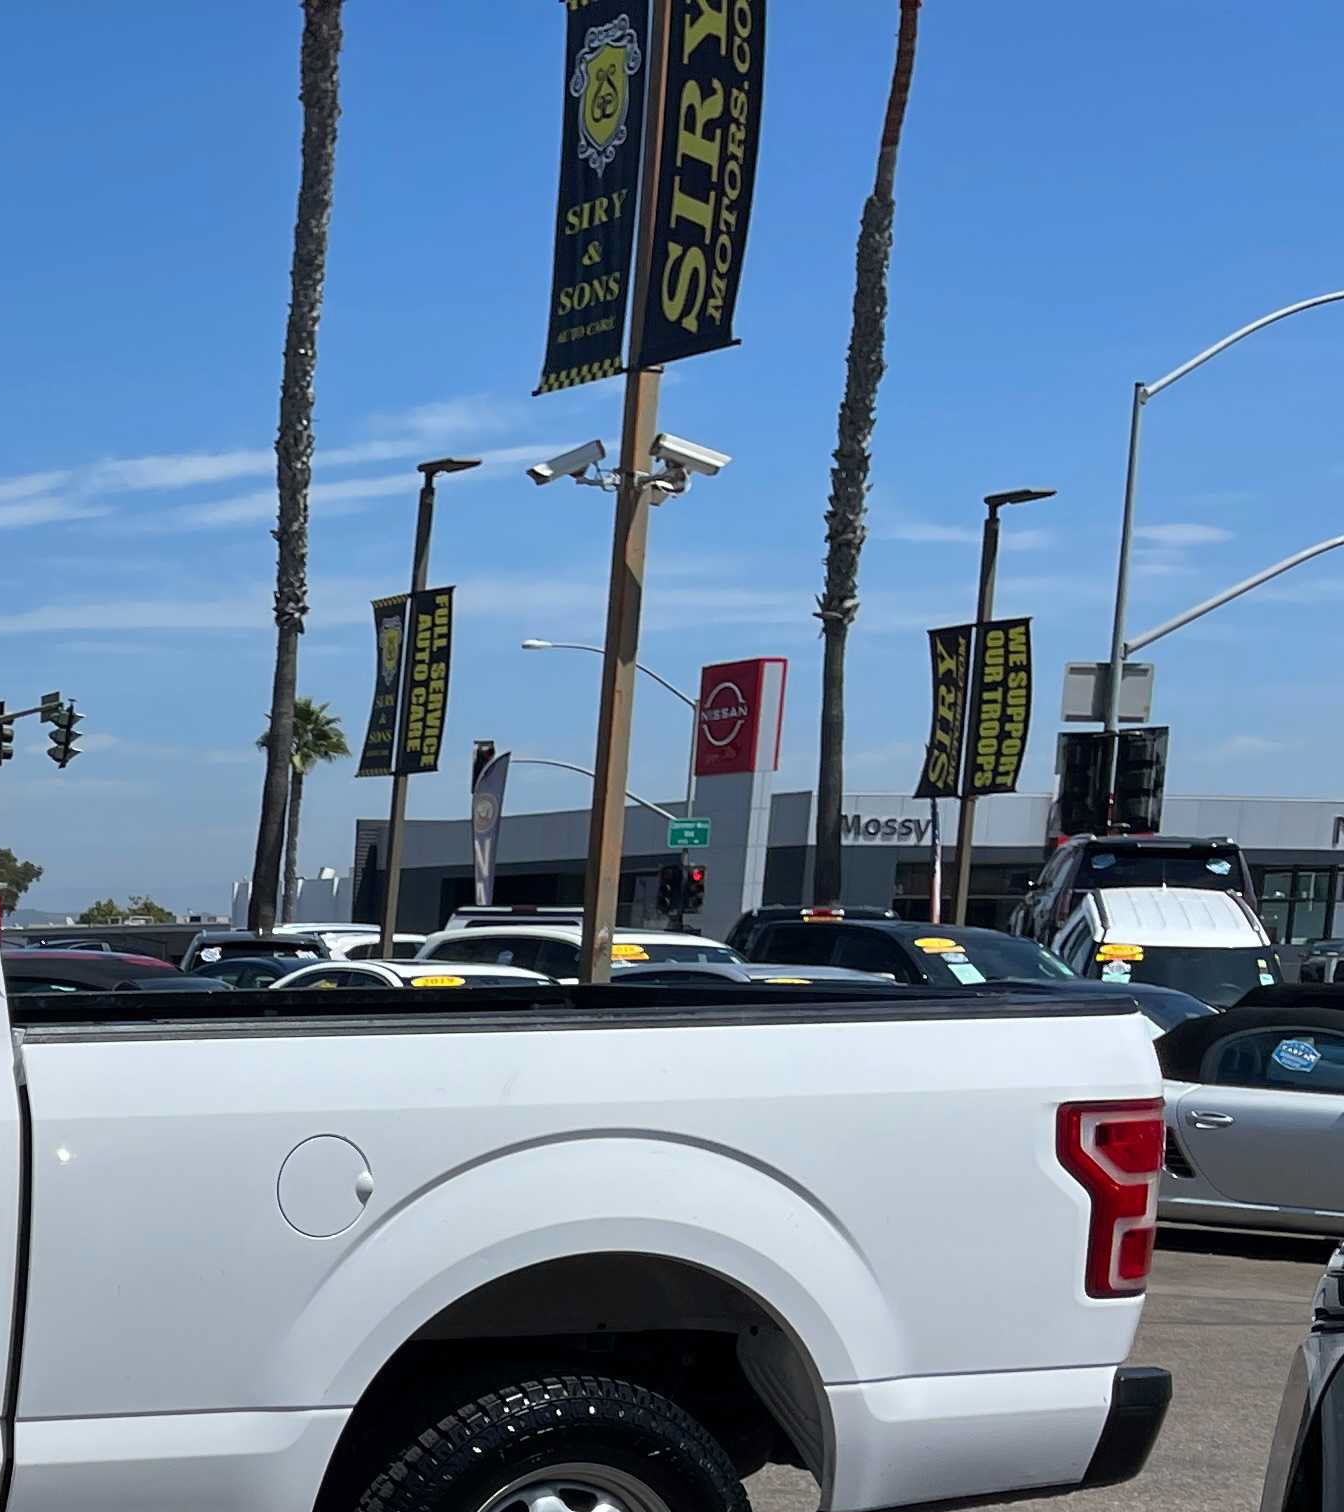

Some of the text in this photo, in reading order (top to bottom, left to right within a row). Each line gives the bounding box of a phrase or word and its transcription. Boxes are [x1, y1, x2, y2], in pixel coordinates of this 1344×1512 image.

[564, 189, 628, 235] SIRY
[662, 0, 727, 333] SIRY
[558, 272, 621, 315] SONS
[581, 241, 602, 266] &
[407, 614, 432, 752] AUTO CARE
[420, 594, 449, 767] FULL SERVICE
[702, 703, 748, 721] NISSAN
[928, 636, 958, 790] SIRY
[974, 629, 1005, 788] OUR TROOPS
[995, 625, 1029, 787] WE SUPPORT
[840, 814, 932, 843] Mossy
